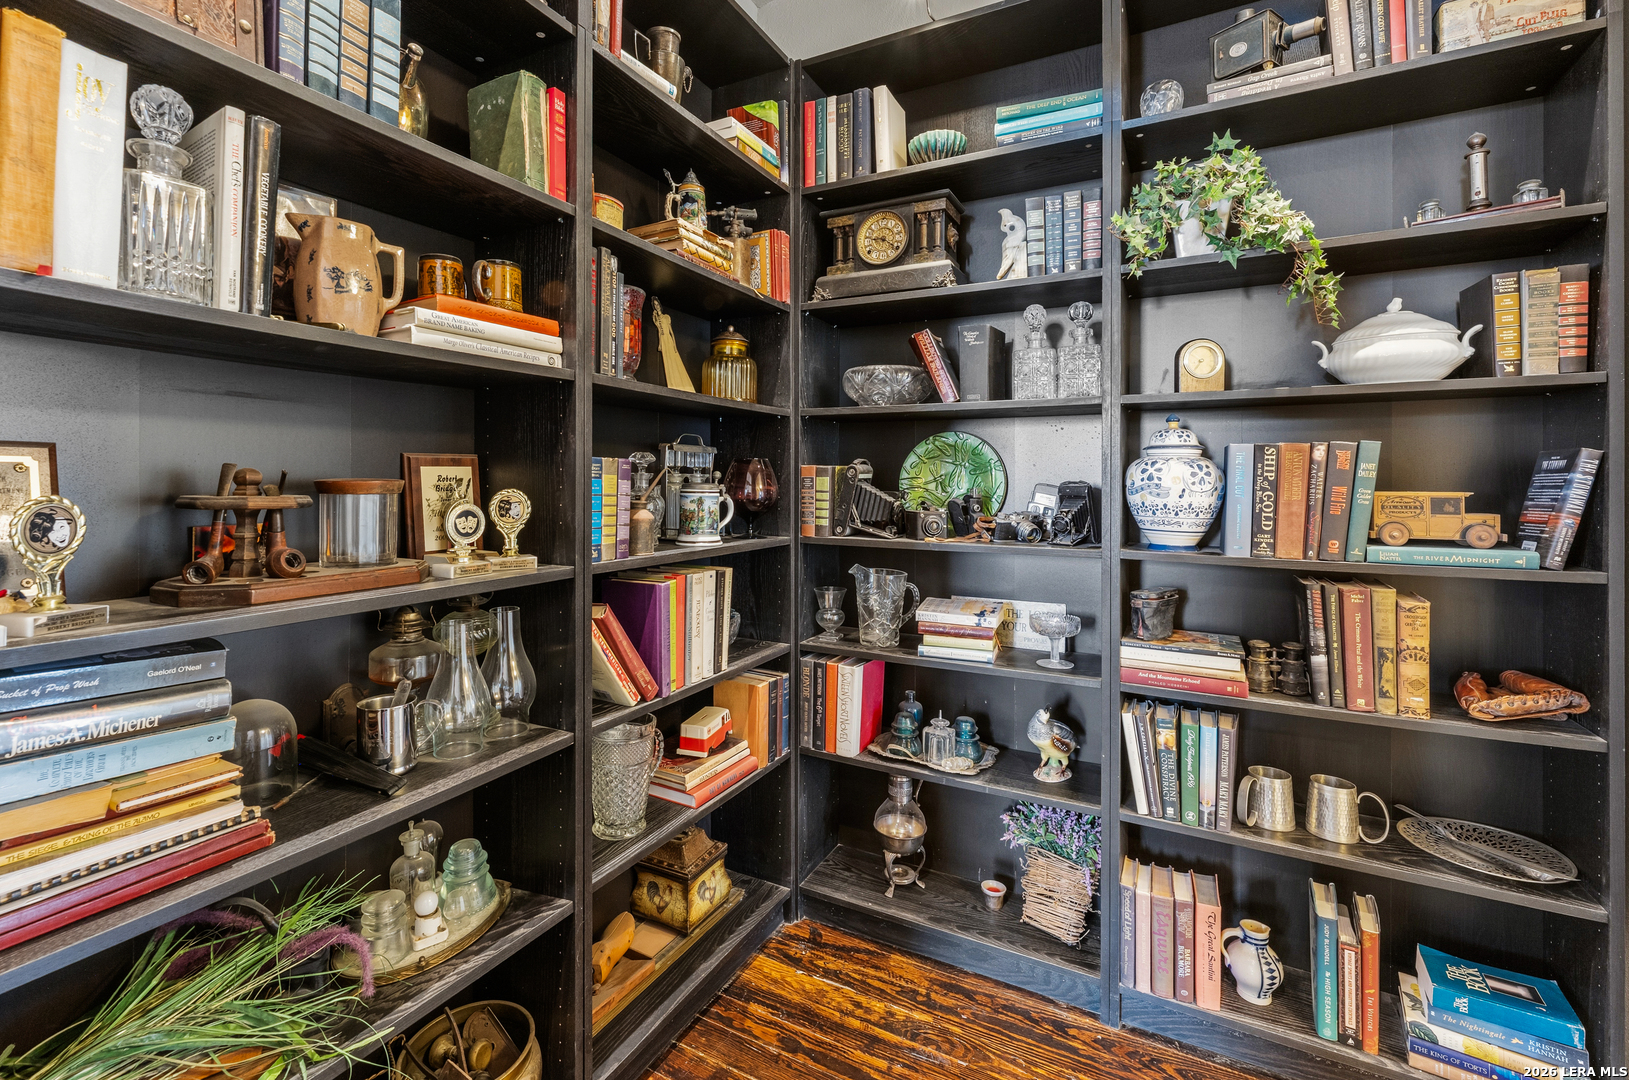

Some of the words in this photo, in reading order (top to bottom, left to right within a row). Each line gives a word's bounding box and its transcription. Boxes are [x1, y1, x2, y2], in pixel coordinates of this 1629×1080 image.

[1516, 16, 1538, 27] CUT
[1540, 9, 1568, 20] PLUG
[1354, 23, 1366, 48] REMAINS
[1248, 72, 1260, 82] Gap
[1260, 70, 1278, 80] Creek
[1066, 94, 1087, 103] OCEAN
[232, 144, 240, 160] THE
[230, 160, 243, 188] Chef's
[259, 172, 270, 216] VEGETABLE
[230, 188, 239, 238] COMPANION
[258, 216, 268, 257] COOKERY
[603, 283, 611, 316] WALKER
[424, 318, 446, 330] BRAND
[446, 322, 463, 332] NAME
[464, 325, 486, 336] BAKING
[431, 312, 450, 322] GREAT
[451, 316, 478, 328] AMERICAN
[443, 338, 458, 348] Margo
[458, 340, 475, 350] Oliver's
[475, 342, 500, 354] Classical
[500, 347, 523, 358] American
[523, 350, 540, 362] Recipes
[922, 330, 942, 370] COLLECTED
[918, 334, 933, 362] WILLIAM
[929, 361, 946, 395] FAULKNER
[1235, 452, 1246, 465] THE
[1263, 446, 1276, 481] SHIP
[1292, 451, 1303, 476] ANTON
[1342, 450, 1352, 470] NELSON
[1360, 462, 1376, 470] JANET
[1579, 458, 1599, 474] THE
[436, 474, 458, 483] Robert
[1235, 465, 1245, 484] FINAL
[1358, 470, 1376, 478] DAILEY
[1234, 484, 1244, 498] CUT
[1260, 480, 1271, 490] of
[1292, 476, 1302, 500] MYRER
[1309, 464, 1318, 506] ZACHARIUS
[1316, 471, 1324, 499] WALTER
[1332, 486, 1348, 502] Wild
[1565, 473, 1594, 516] STOWAWAY
[1261, 490, 1275, 531] GOLD
[1330, 502, 1346, 516] Fire
[1308, 510, 1321, 545] Songbird
[1379, 550, 1399, 558] LILIAN
[1450, 554, 1501, 565] MIDNIGHT
[1006, 608, 1024, 619] THE
[1312, 590, 1324, 628] SUPERNOTES
[1354, 612, 1362, 622] The
[46, 622, 70, 632] ROBERT
[70, 618, 96, 628] BRIDGET
[1001, 620, 1027, 632] YOUR
[146, 667, 177, 678] Gaelord
[178, 664, 202, 673] O'Neal
[606, 648, 622, 674] AMERICAN
[31, 686, 43, 697] of
[45, 684, 71, 694] Prop
[72, 677, 100, 689] Wash
[802, 666, 810, 698] BLONDE
[838, 672, 853, 698] SIXTEEN
[1156, 674, 1182, 682] Mountains
[837, 696, 852, 718] SHORT
[4, 732, 66, 759] James
[66, 726, 86, 744] A.
[87, 714, 162, 740] Michener
[836, 718, 852, 744] NOVELS
[1184, 729, 1196, 746] Daily
[1222, 734, 1230, 750] JAMES
[50, 758, 62, 788] COMPLETE
[84, 752, 96, 782] BROTHERS
[1220, 750, 1230, 778] PATTERSON
[37, 770, 49, 782] THE
[1160, 752, 1170, 802] CONSPIRACY
[1168, 772, 1176, 802] DIVINE
[1220, 780, 1229, 800] MARY
[1218, 800, 1228, 819] MARY
[6, 850, 25, 862] THE
[28, 842, 59, 860] SIEGE
[70, 830, 102, 846] TAKING
[102, 824, 115, 834] OF
[116, 820, 132, 830] THE
[133, 812, 160, 826] ALAMO
[1124, 888, 1132, 912] Speed
[1124, 912, 1132, 921] of
[1208, 911, 1218, 930] The
[1124, 920, 1132, 941] Light
[1152, 910, 1172, 975] Esquire
[1205, 930, 1217, 952] Great
[1206, 952, 1217, 982] Santini
[1446, 963, 1468, 981] THE
[1324, 978, 1332, 995] HIGH
[1461, 964, 1491, 995] BOOK
[1324, 996, 1332, 1024] SEASON
[1453, 996, 1462, 1008] THE
[1459, 997, 1469, 1014] BOOK
[1442, 1014, 1456, 1024] The
[1460, 1020, 1506, 1040] Nightingale
[1528, 1040, 1567, 1056] KRISTIN
[1528, 1046, 1569, 1064] HANNAH
[1413, 1044, 1428, 1054] THE
[1430, 1048, 1449, 1061] KING
[1450, 1057, 1460, 1065] OF
[1462, 1061, 1488, 1074] TORTS
